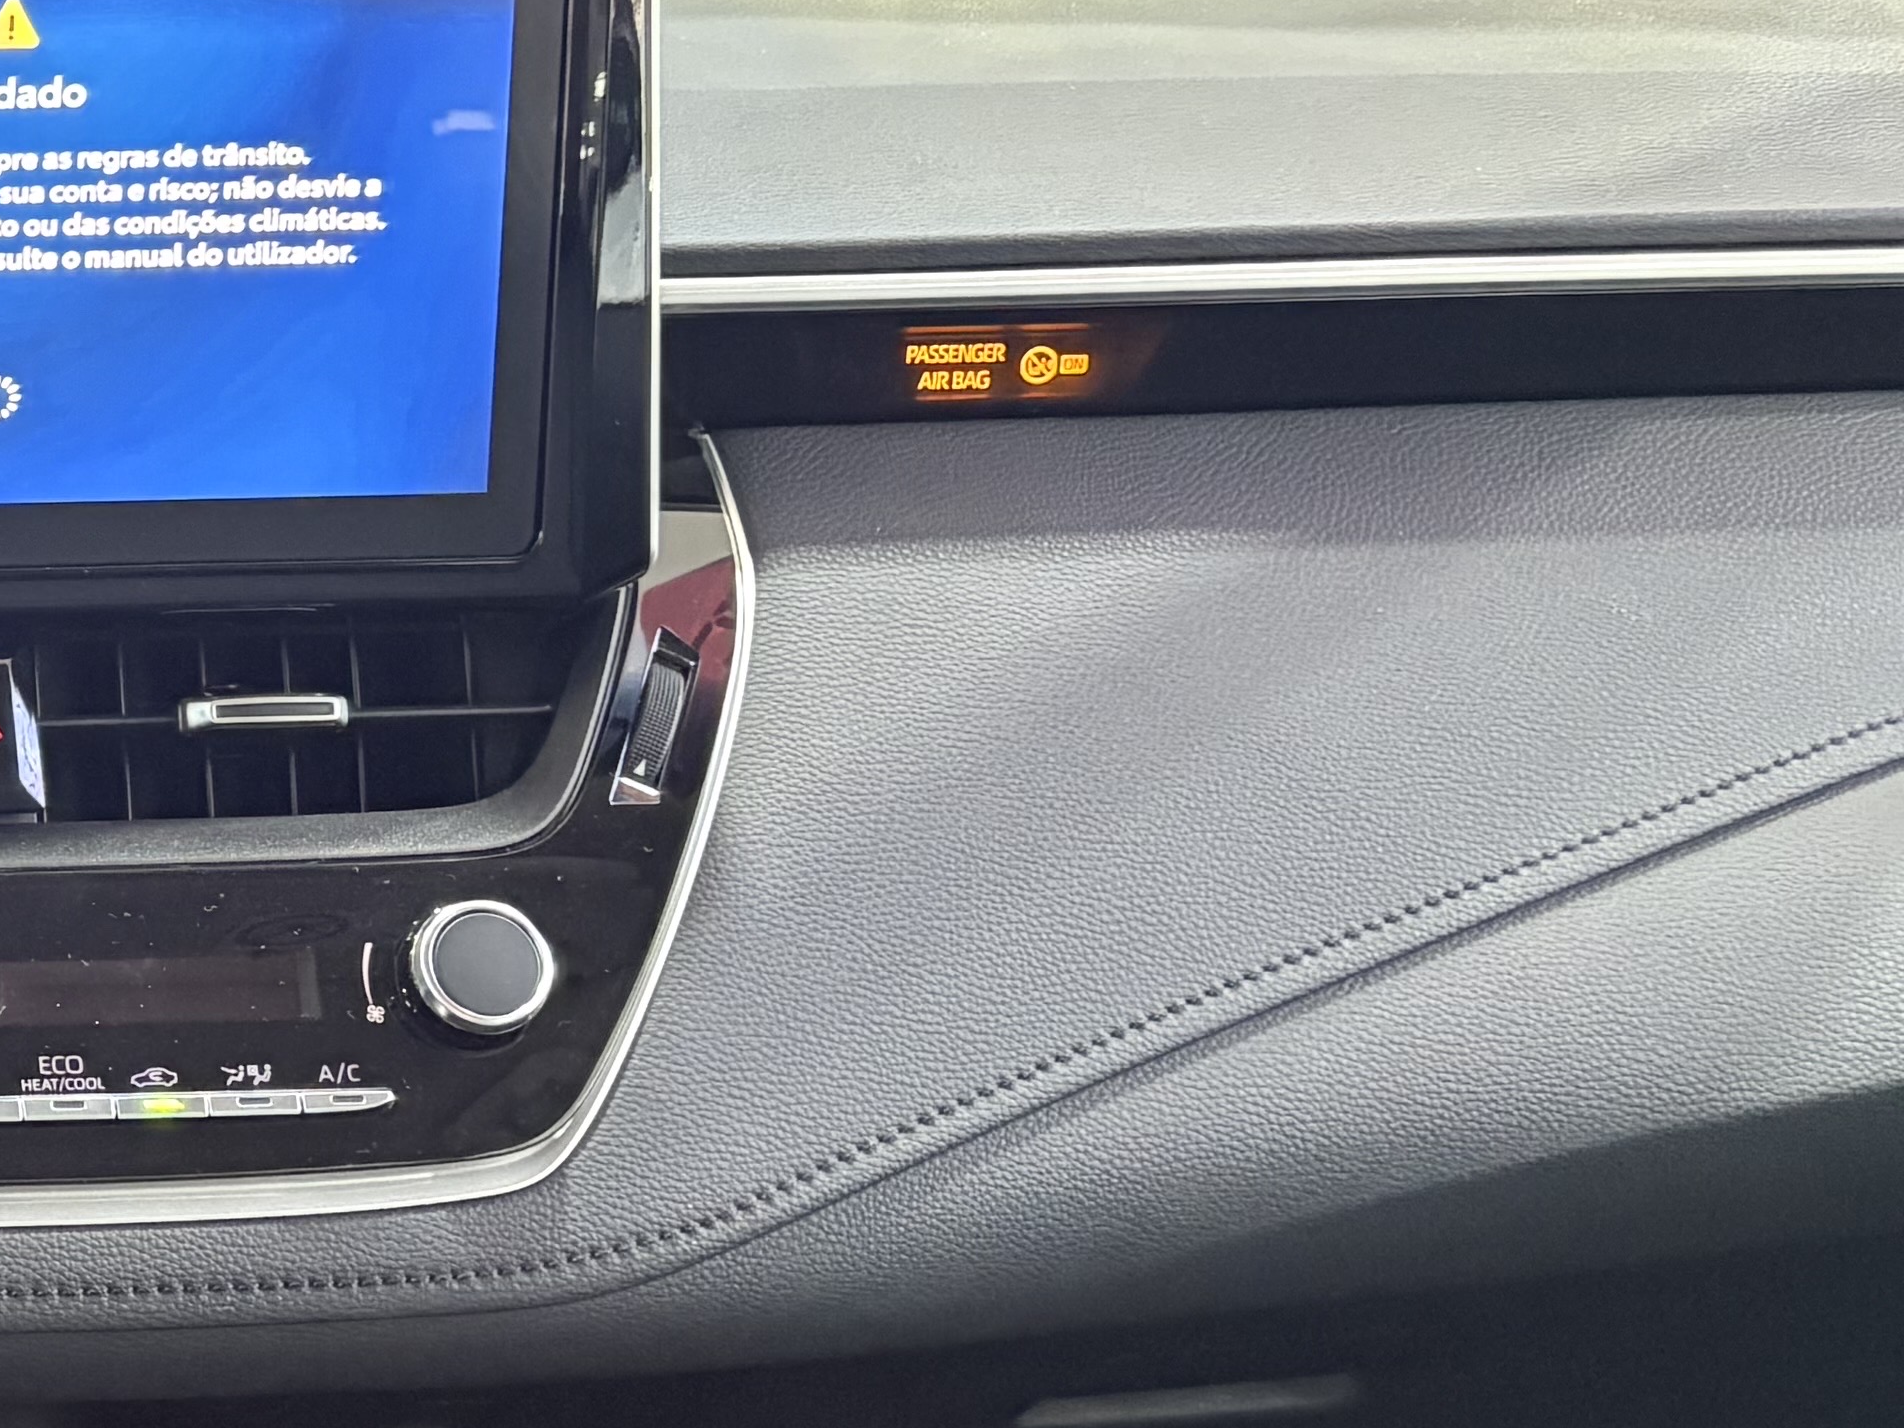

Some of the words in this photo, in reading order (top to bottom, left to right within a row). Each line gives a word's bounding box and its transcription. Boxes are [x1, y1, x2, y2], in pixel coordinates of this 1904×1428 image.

[43, 151, 72, 170] as
[77, 147, 160, 174] regras
[163, 143, 198, 169] de
[202, 141, 312, 167] trânsito.
[49, 180, 123, 204] conta
[127, 181, 144, 202] e
[149, 177, 220, 204] risco;
[223, 175, 274, 201] não
[277, 173, 361, 199] desvie
[364, 177, 383, 198] a
[23, 217, 59, 238] ou
[62, 211, 110, 237] das
[114, 209, 246, 239] condições
[249, 206, 390, 233] climáticas.
[62, 248, 81, 270] o
[85, 242, 184, 269] manual
[187, 241, 224, 267] do
[227, 239, 358, 266] utilizador.
[905, 343, 1007, 364] PASSENGER
[917, 371, 949, 390] AIR
[952, 369, 991, 390] BAG
[38, 1055, 84, 1076] ECO
[318, 1063, 361, 1084] A/C
[20, 1076, 107, 1093] HEAT/COOL
